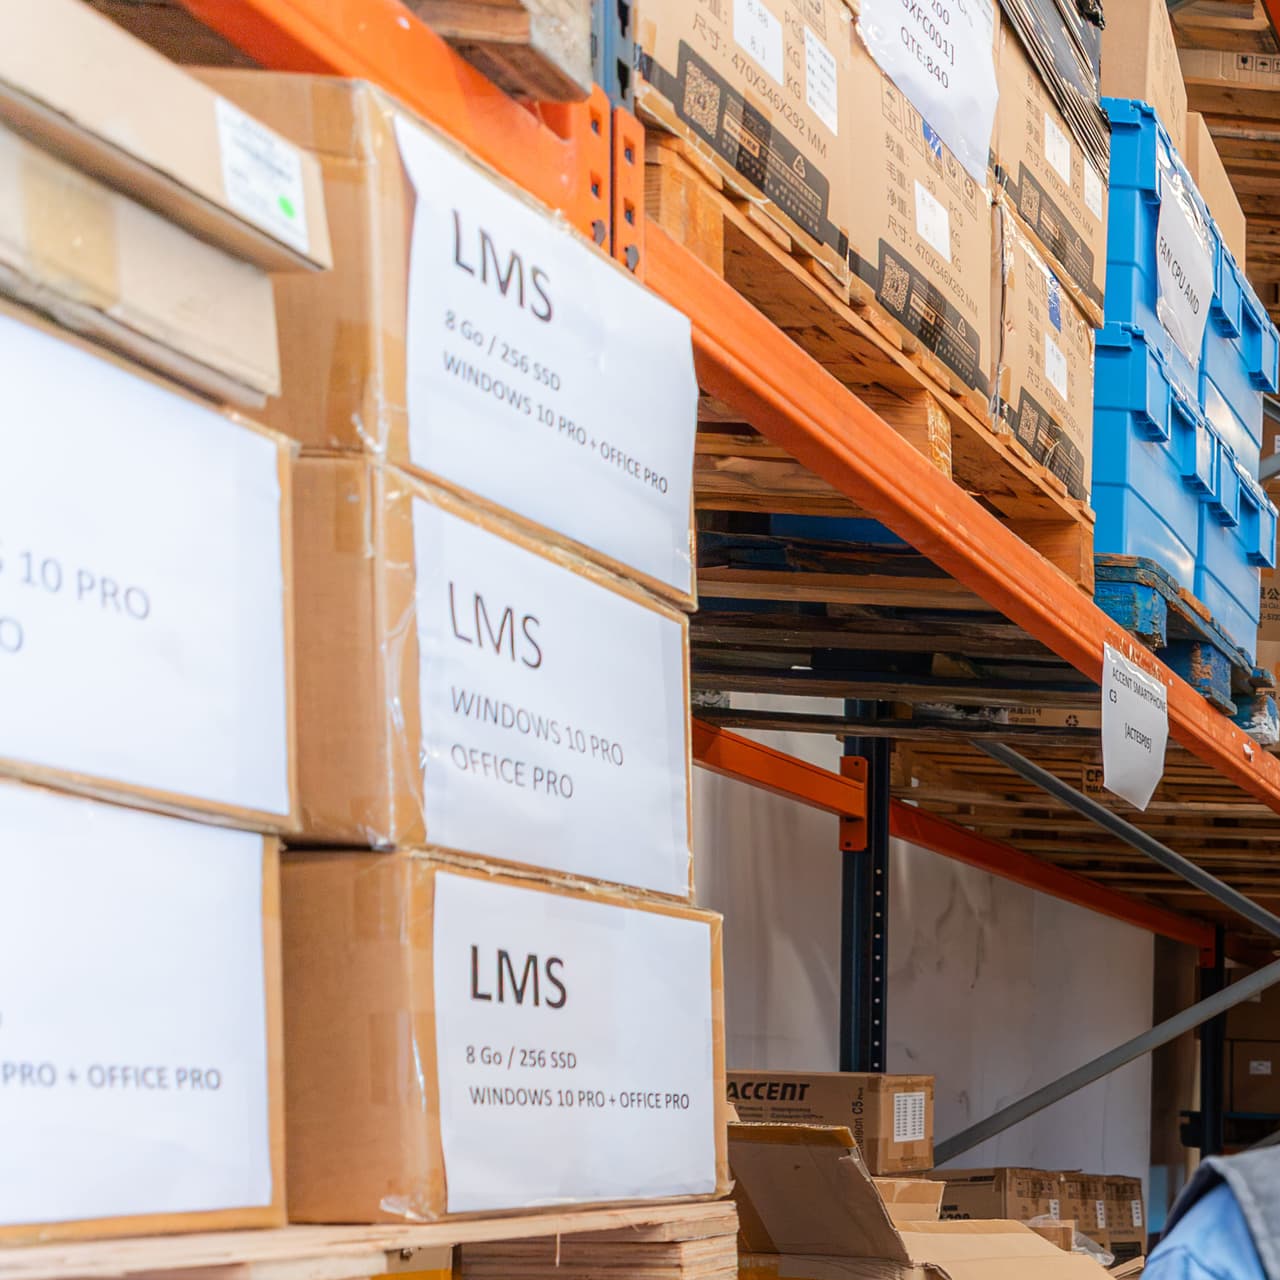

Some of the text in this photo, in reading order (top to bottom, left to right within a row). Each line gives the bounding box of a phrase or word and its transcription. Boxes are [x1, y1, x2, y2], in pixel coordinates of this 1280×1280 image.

[900, 26, 949, 89] QTE:840
[452, 208, 553, 323] LMS
[1159, 235, 1200, 315] FAN CPU AMD
[444, 309, 456, 331] 8
[460, 319, 484, 348] Go
[500, 342, 530, 375] 256
[532, 362, 562, 392] SSD
[442, 350, 532, 416] WINDOWS
[536, 404, 555, 428] 10
[557, 415, 587, 447] PRO
[600, 441, 641, 480] OFFICE
[643, 466, 669, 494] PRO
[19, 551, 151, 621] 10 PRO
[449, 580, 543, 669] LMS
[450, 685, 624, 767] WINDOWS 10 PRO
[450, 743, 574, 799] OFFICE PRO
[470, 944, 568, 1010] LMS
[1, 1060, 57, 1090] PRO
[87, 1063, 171, 1091] OFFICE
[174, 1066, 222, 1092] PRO
[465, 1045, 577, 1071] 8 Go / 256 SSD
[727, 1081, 812, 1101] ACCENT
[469, 1086, 553, 1109] WINDOWS
[557, 1089, 574, 1108] 10
[577, 1090, 605, 1109] PRO
[619, 1091, 662, 1110] OFFICE
[664, 1092, 690, 1111] PRO
